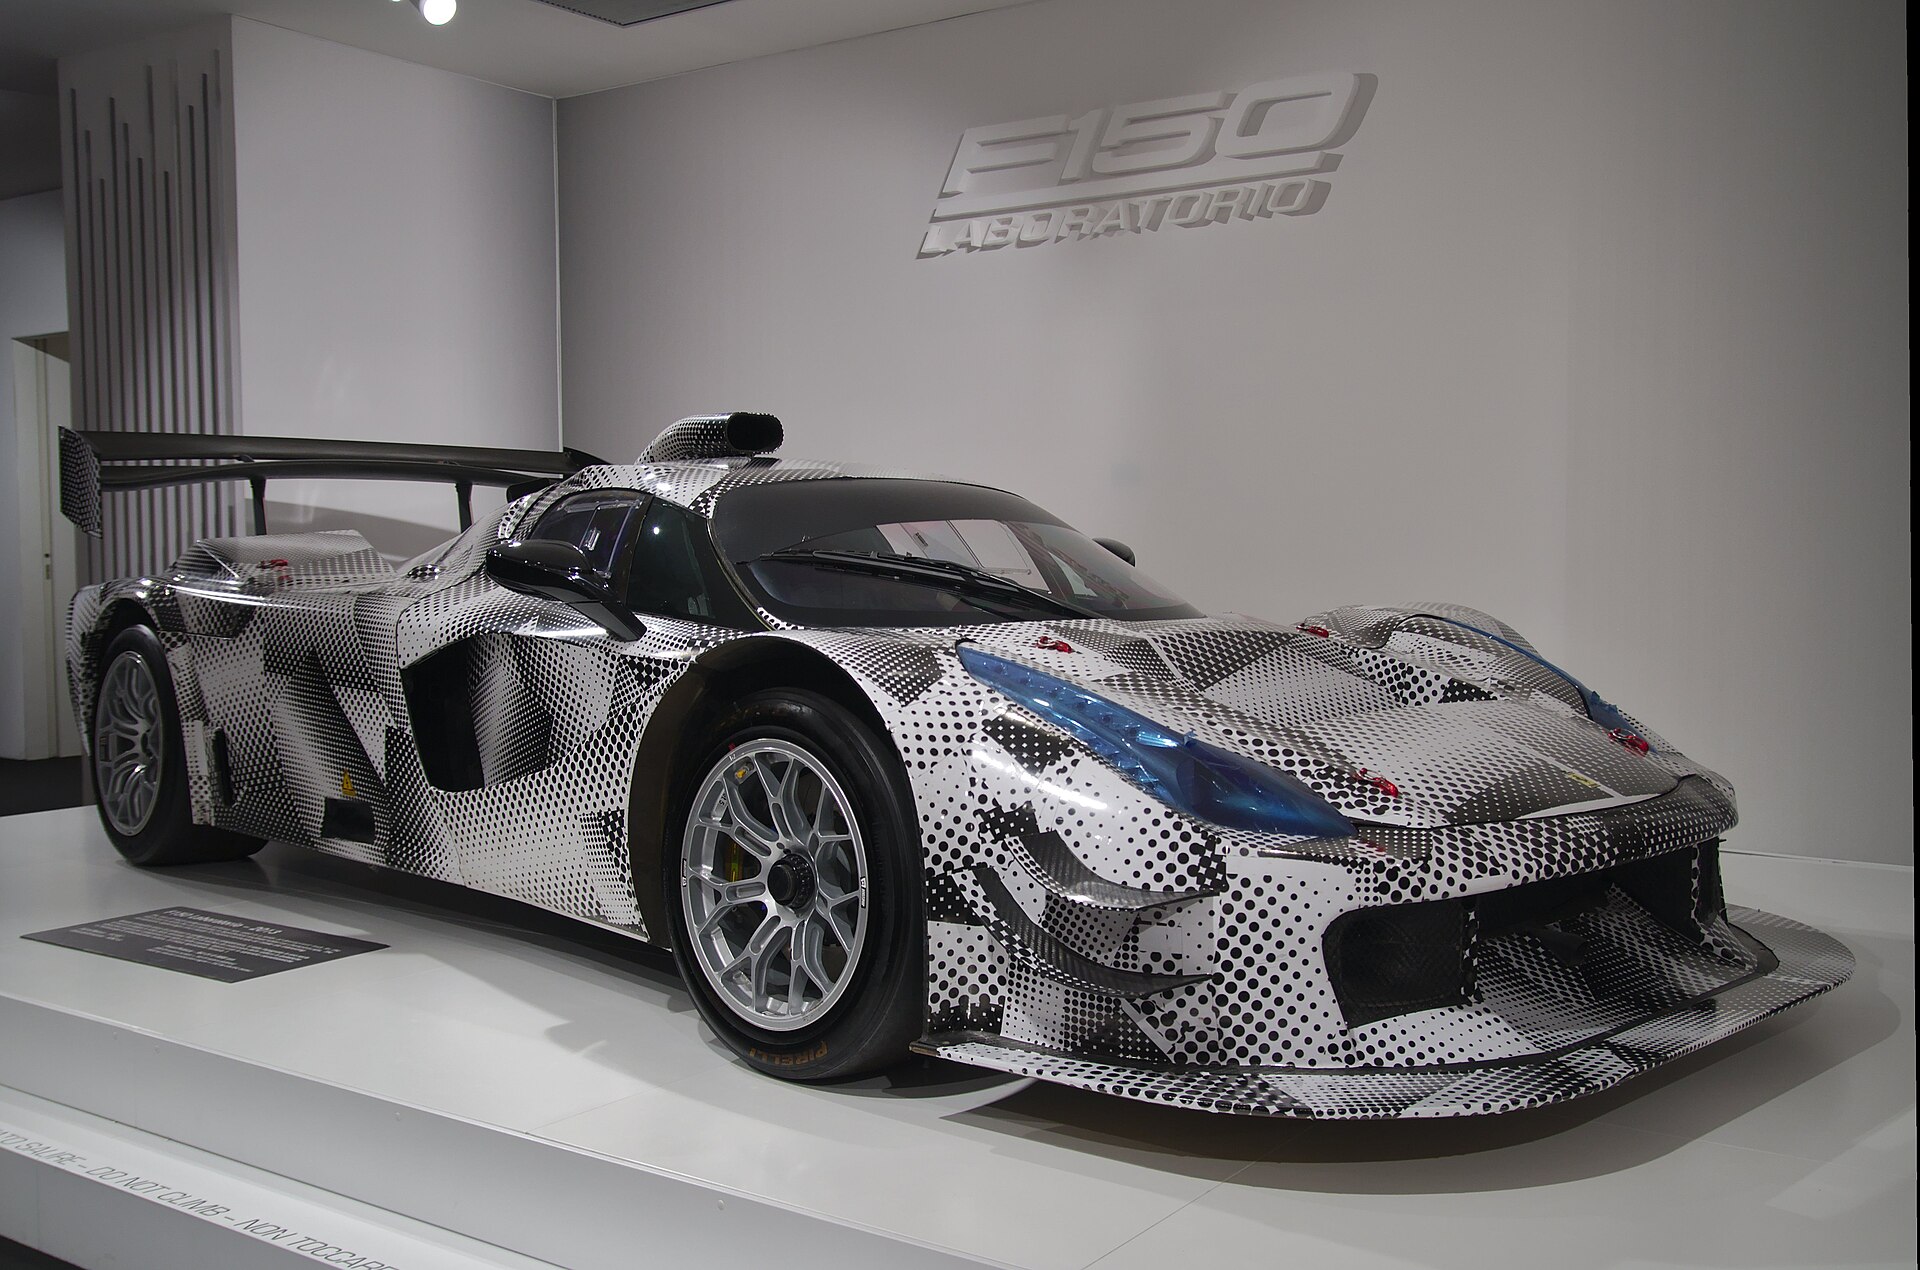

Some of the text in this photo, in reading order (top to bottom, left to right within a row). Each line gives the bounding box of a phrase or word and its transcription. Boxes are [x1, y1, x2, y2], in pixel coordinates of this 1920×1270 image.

[937, 72, 1379, 200] F150
[915, 179, 1332, 260] LABORATORIO
[748, 1040, 828, 1065] PIRELLI
[15, 1142, 86, 1166] SALIRE
[86, 1166, 128, 1180] DO
[115, 1176, 171, 1194] NOT
[157, 1191, 230, 1217] CLIMB
[234, 1219, 298, 1241] NON
